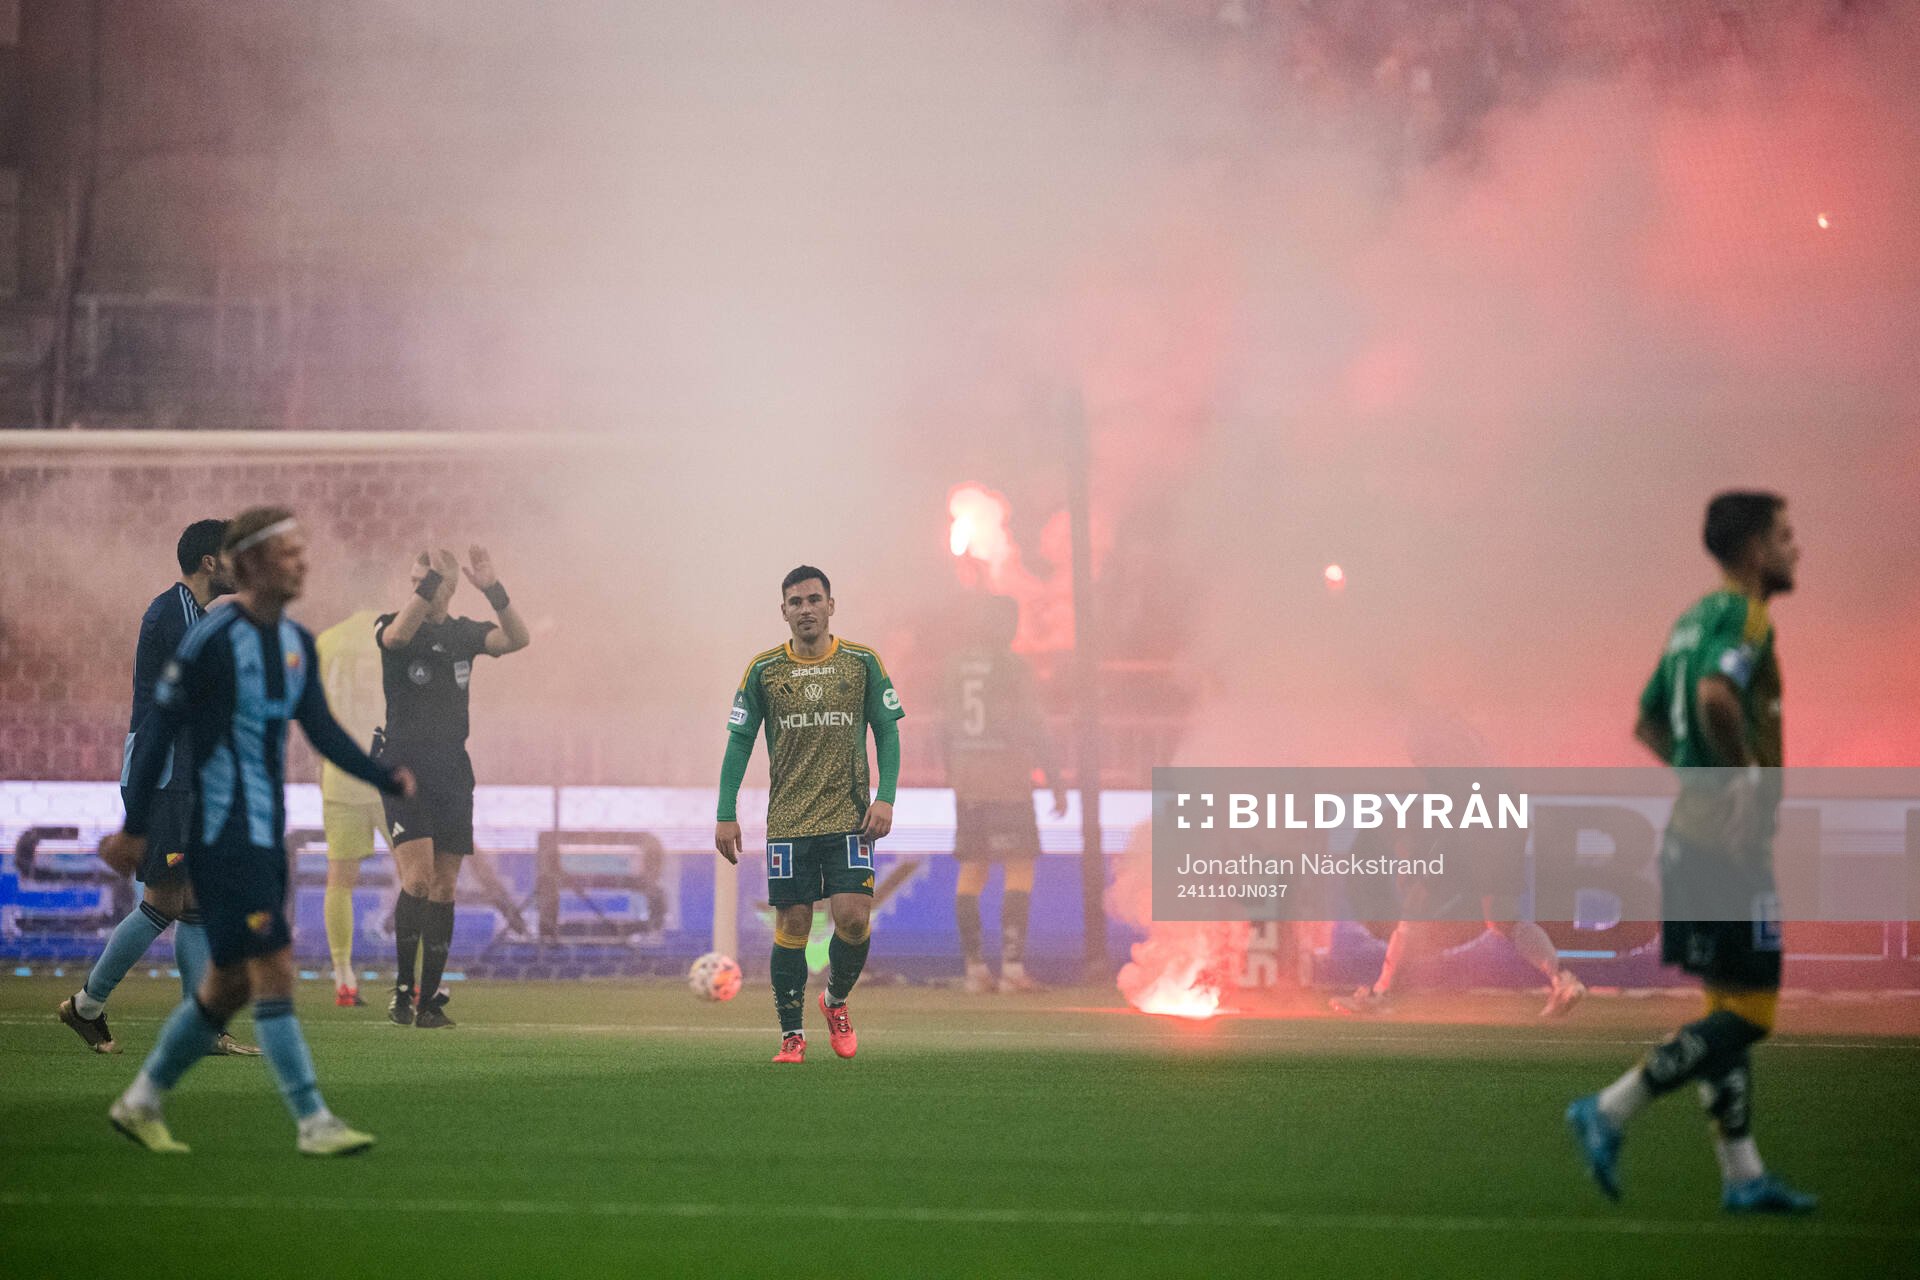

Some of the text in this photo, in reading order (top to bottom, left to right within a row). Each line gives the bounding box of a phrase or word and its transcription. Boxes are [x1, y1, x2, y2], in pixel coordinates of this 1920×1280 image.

[791, 666, 835, 678] stadium
[963, 679, 985, 736] 5
[779, 711, 853, 729] HOLMEN
